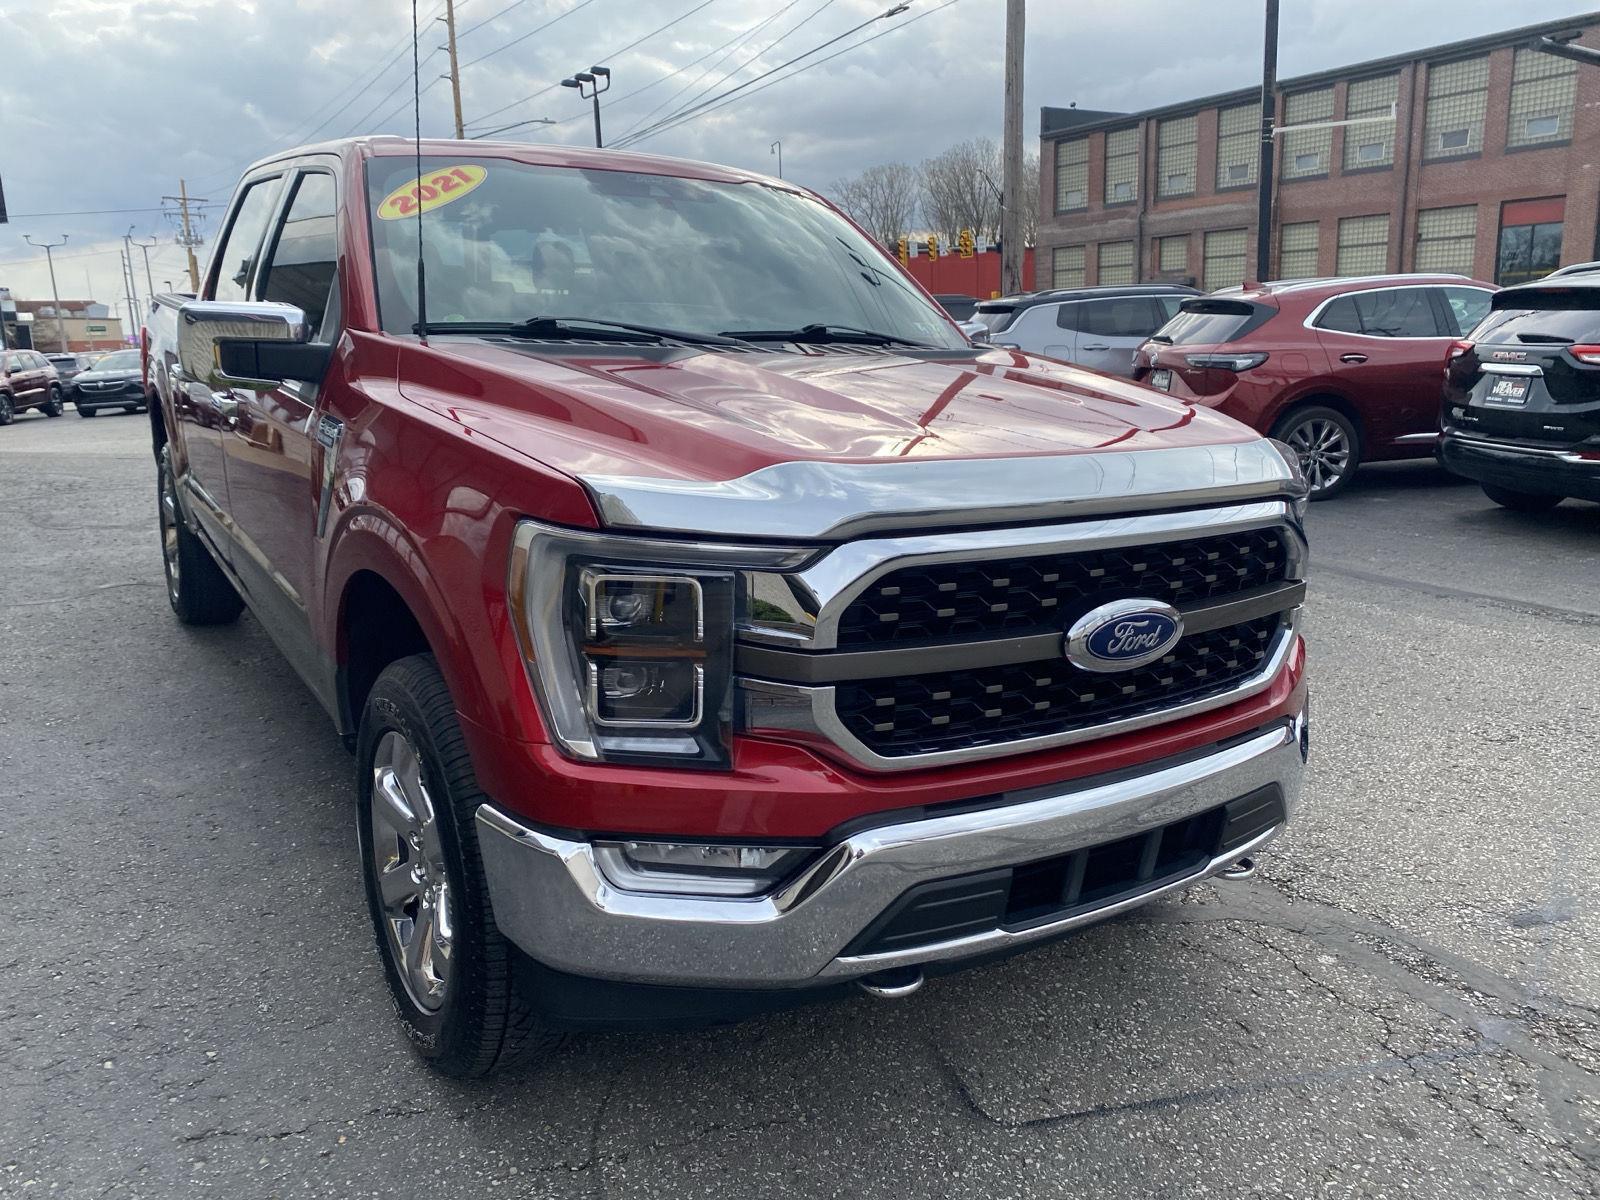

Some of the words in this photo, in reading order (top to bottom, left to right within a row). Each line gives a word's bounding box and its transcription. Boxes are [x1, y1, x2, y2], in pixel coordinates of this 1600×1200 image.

[389, 168, 475, 214] 2021
[1492, 351, 1528, 361] GMC
[1492, 386, 1525, 396] WEAVER
[1107, 620, 1162, 654] Ford
